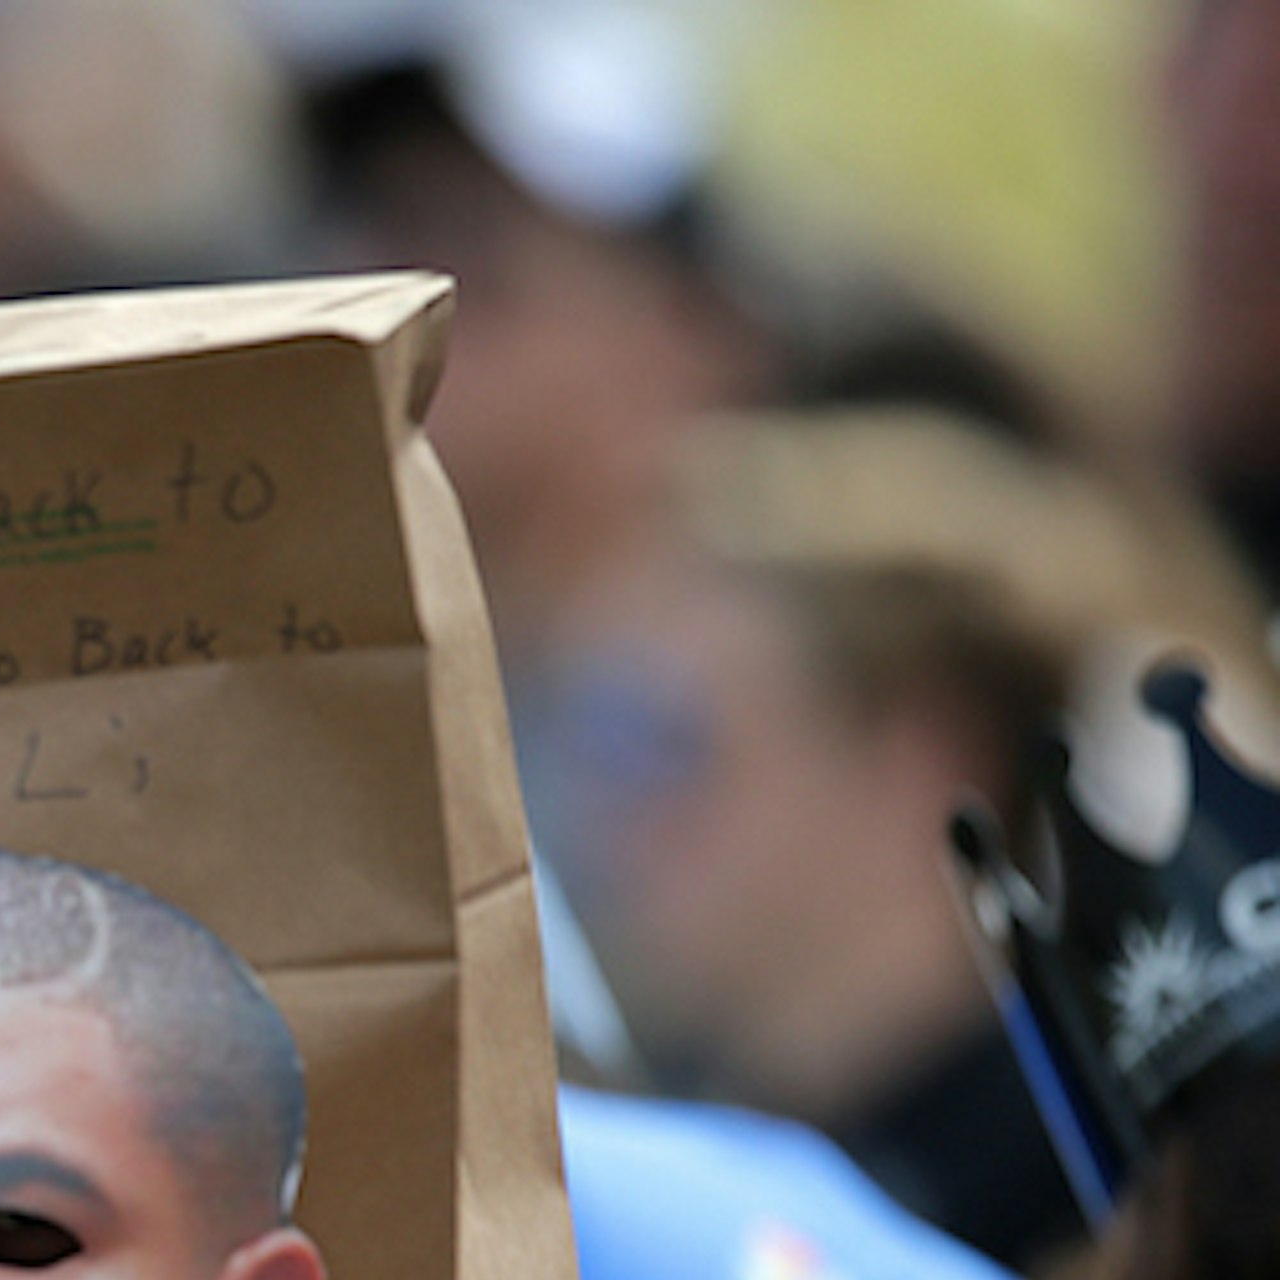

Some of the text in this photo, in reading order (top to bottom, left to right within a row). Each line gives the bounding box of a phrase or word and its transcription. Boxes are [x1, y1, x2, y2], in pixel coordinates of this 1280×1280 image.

[168, 440, 278, 524] to
[70, 616, 220, 676] Back
[278, 604, 345, 655] to
